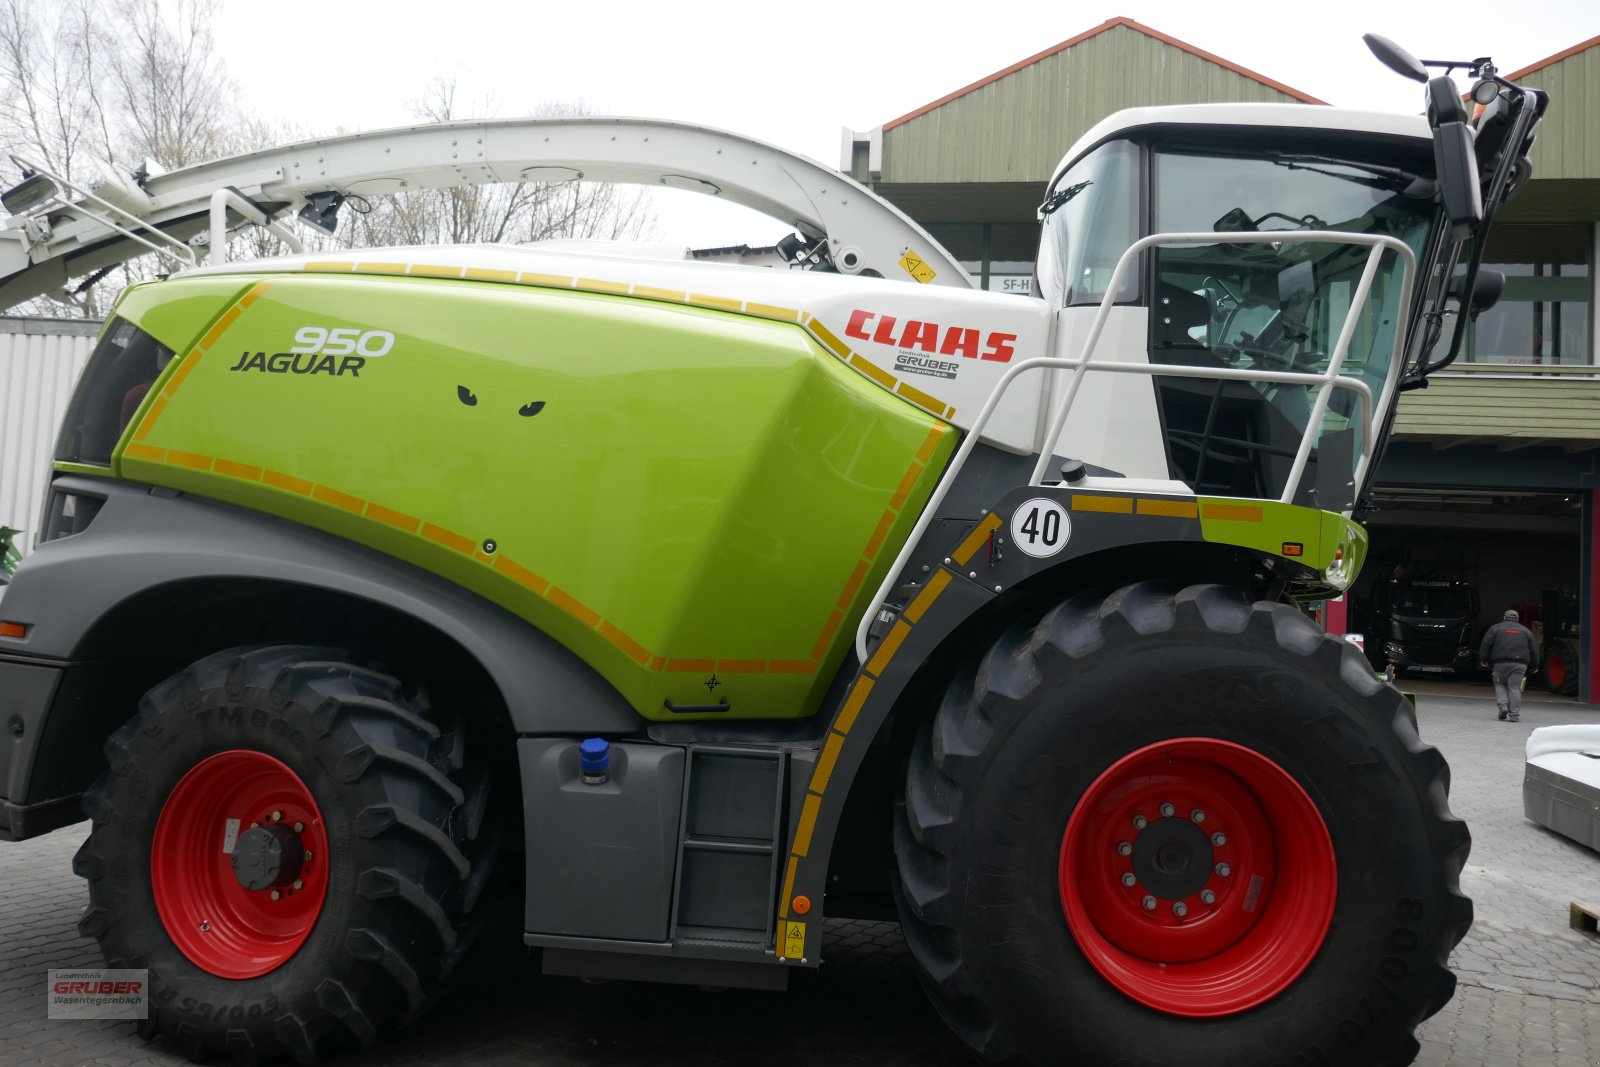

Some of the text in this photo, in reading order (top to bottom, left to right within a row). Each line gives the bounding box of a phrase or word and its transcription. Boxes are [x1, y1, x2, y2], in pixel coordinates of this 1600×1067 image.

[290, 326, 395, 357] 950
[845, 309, 1017, 363] CLAAS
[230, 351, 366, 377] JAGUAR
[896, 355, 960, 372] GRUBER
[1020, 507, 1061, 546] 40
